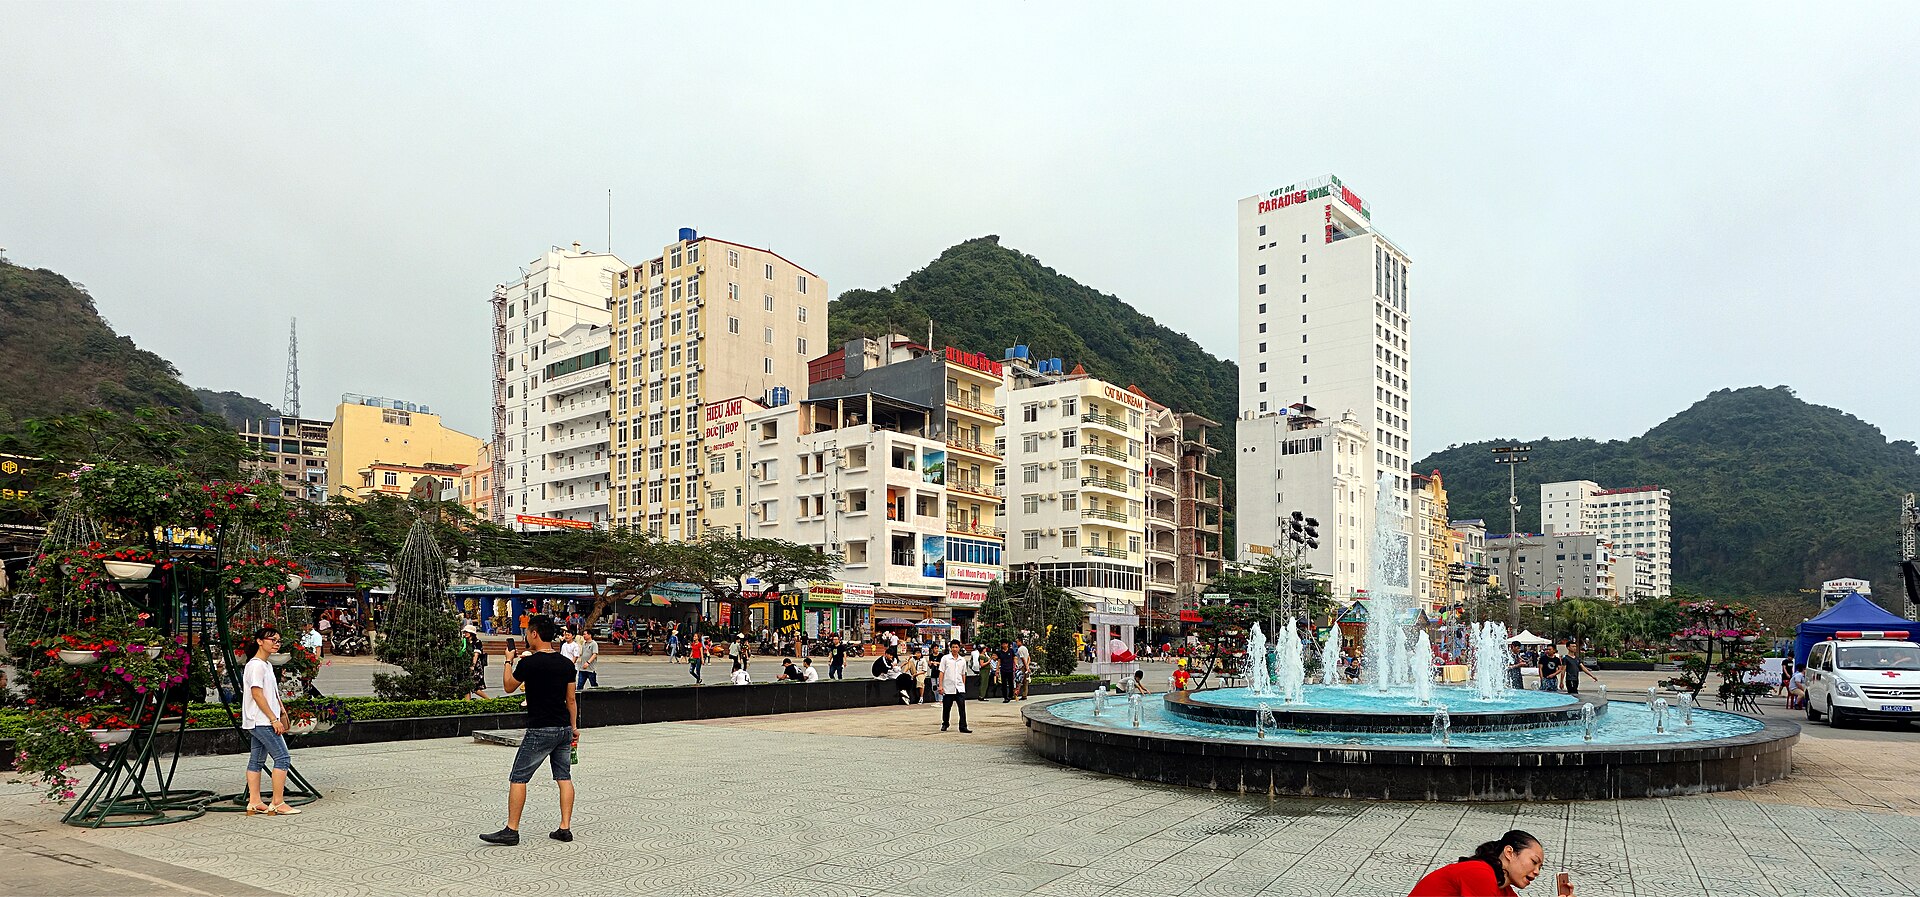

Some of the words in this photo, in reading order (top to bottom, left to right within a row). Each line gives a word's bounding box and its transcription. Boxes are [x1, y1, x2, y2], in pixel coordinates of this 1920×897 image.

[1258, 190, 1307, 214] PARADISE
[1124, 393, 1144, 410] DREAM
[976, 570, 987, 580] Party
[780, 591, 800, 606] CÁT
[970, 591, 981, 602] Party
[783, 605, 799, 620] BÀ
[780, 622, 800, 635] VIEW
